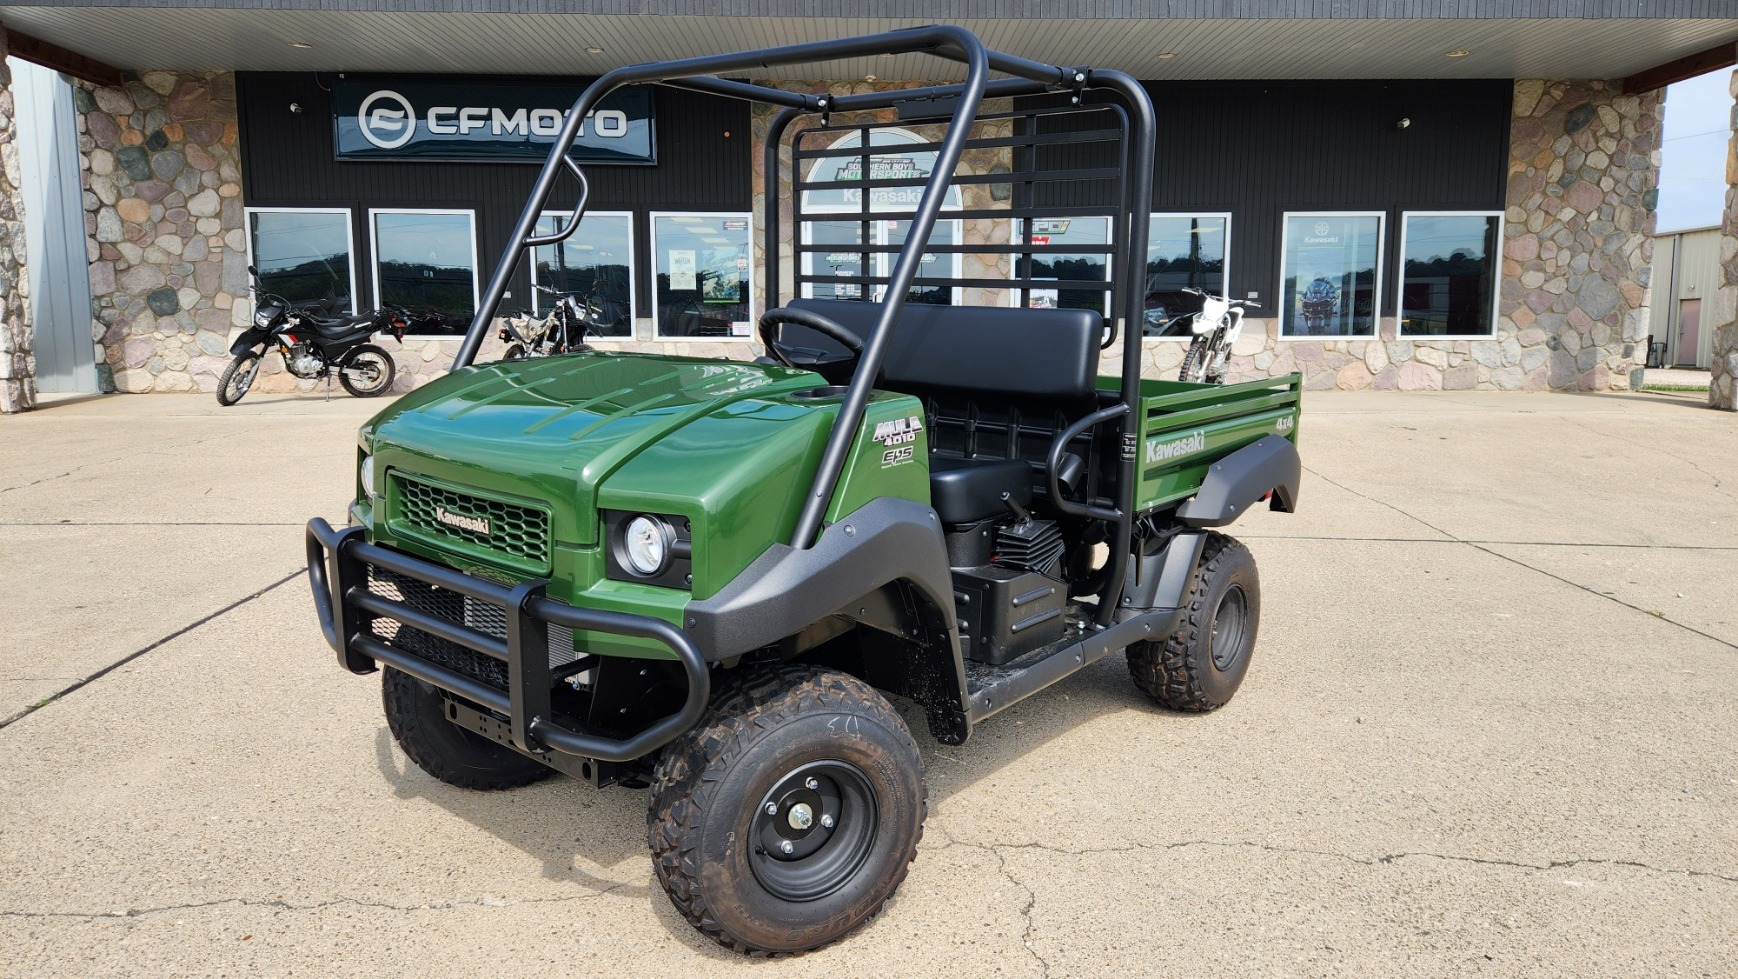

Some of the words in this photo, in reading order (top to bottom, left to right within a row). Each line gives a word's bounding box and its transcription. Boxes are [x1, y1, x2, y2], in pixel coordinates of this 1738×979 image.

[848, 162, 891, 171] SOUHERN
[892, 162, 914, 170] BOYS
[838, 169, 921, 180] MOTRSPORTS
[872, 416, 923, 441] MULE
[1276, 415, 1293, 430] 4x4
[883, 433, 916, 446] 4010
[1145, 430, 1205, 463] Kawasaki
[436, 506, 489, 534] Kawasaki
